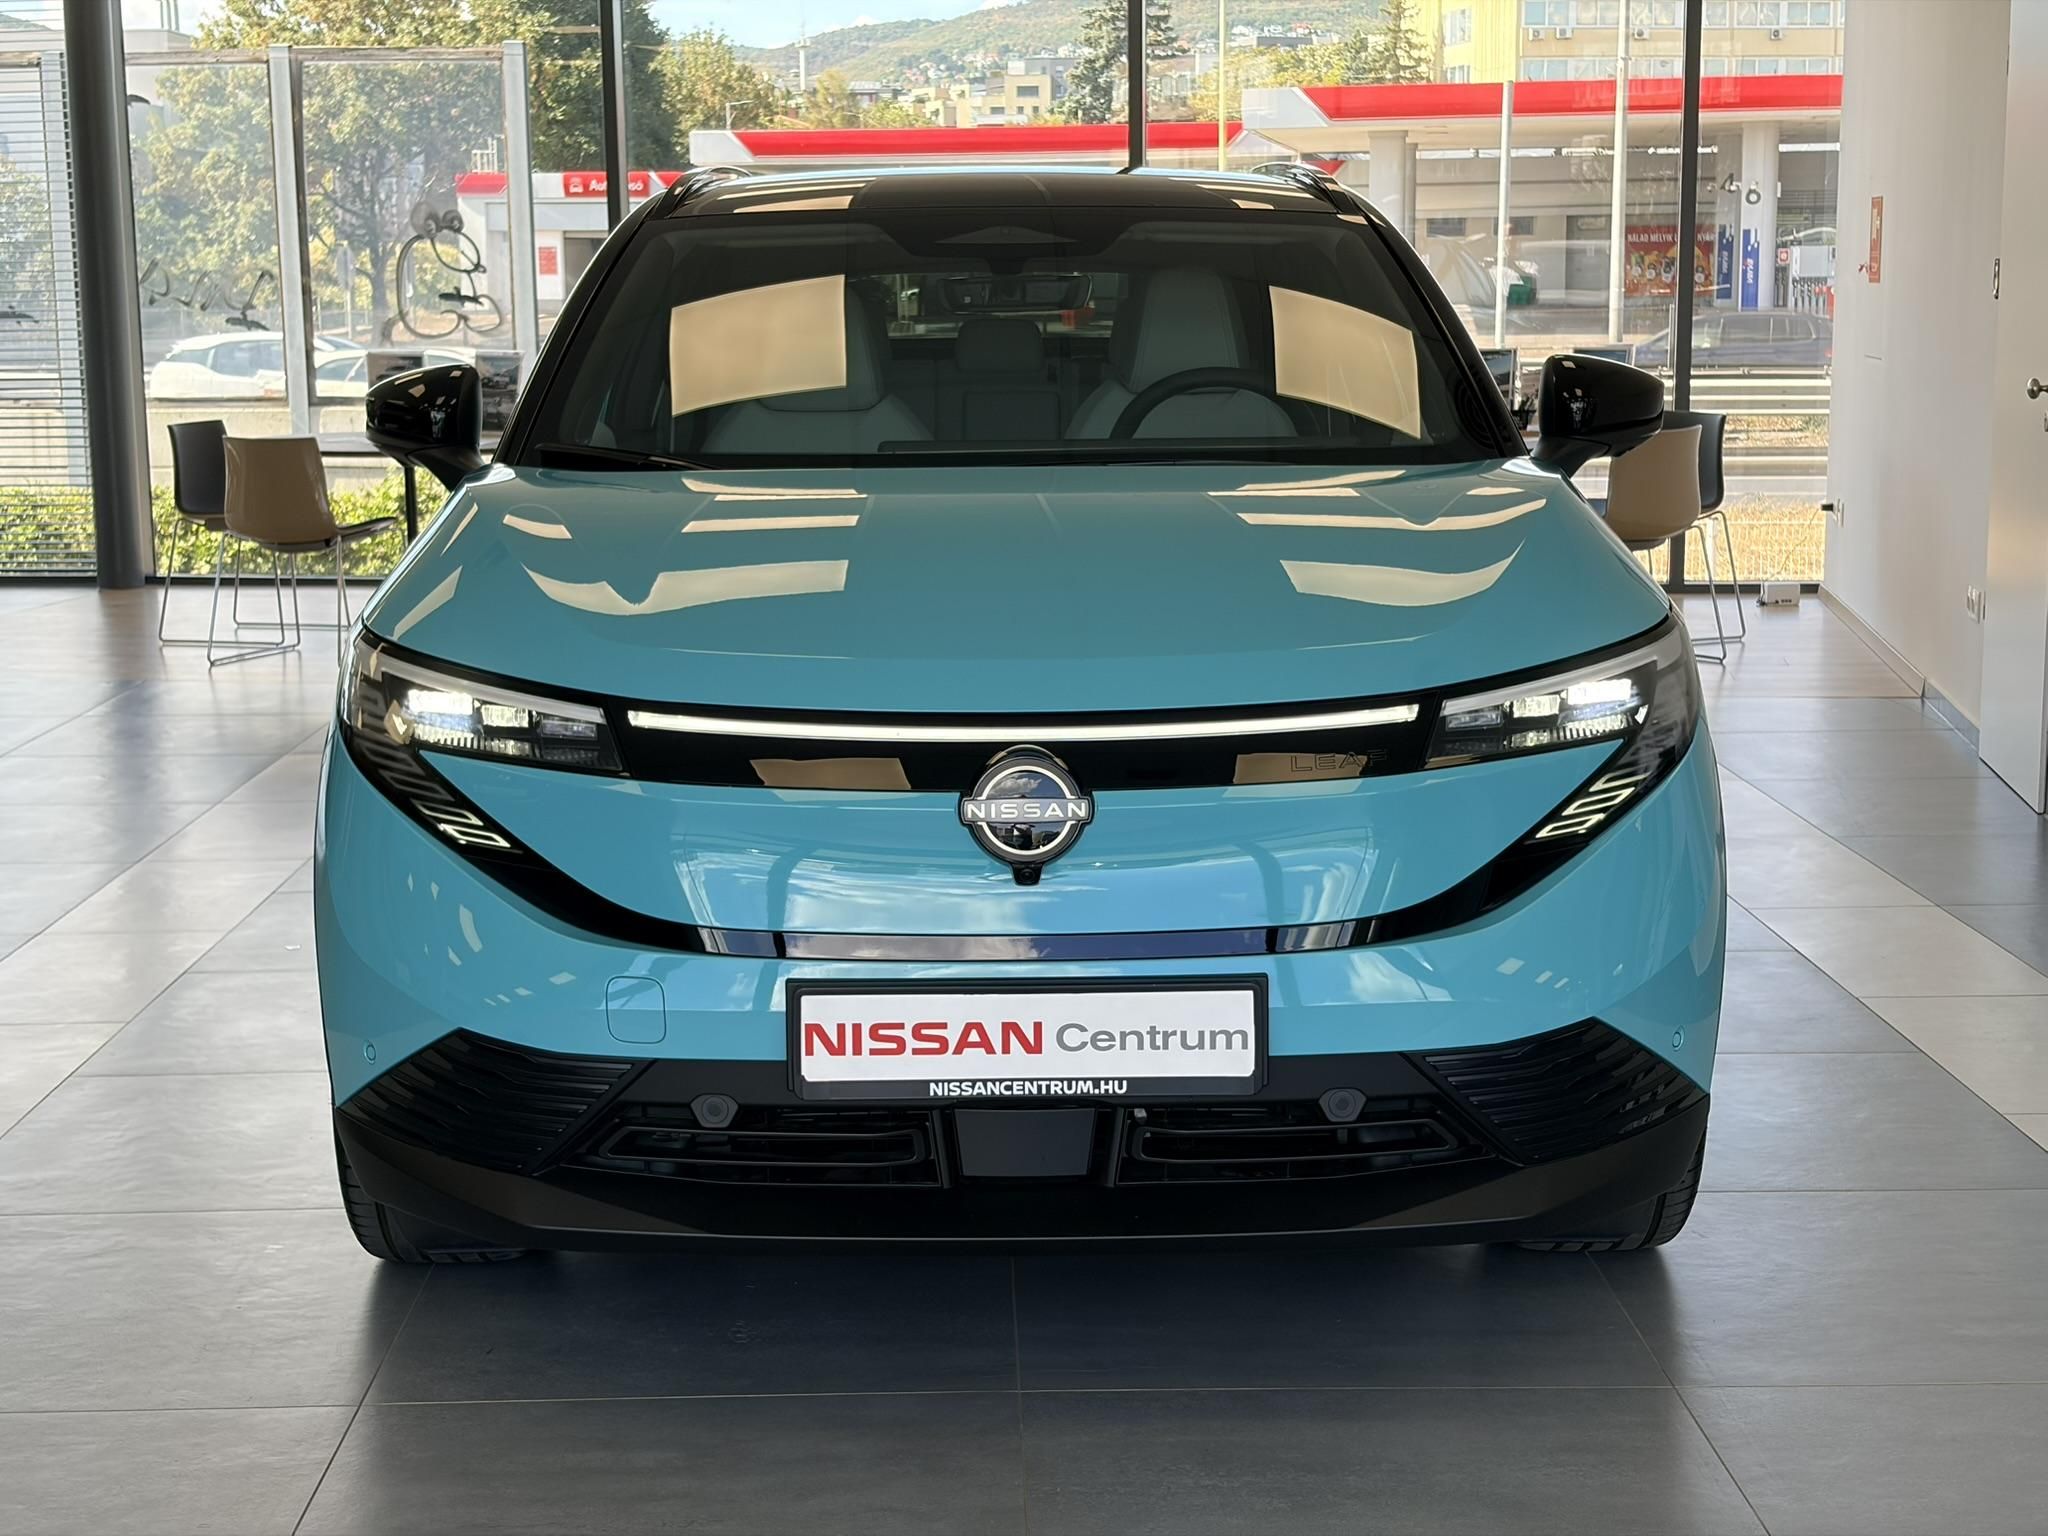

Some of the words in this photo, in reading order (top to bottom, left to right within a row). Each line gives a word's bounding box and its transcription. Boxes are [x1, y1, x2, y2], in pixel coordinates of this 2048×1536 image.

[1290, 749, 1387, 772] LEAF
[967, 802, 1086, 818] NISSAN
[804, 1021, 1042, 1056] NISSAN
[1056, 1023, 1249, 1051] Centrum
[929, 1080, 1127, 1096] NISSANCENTRUM.HU
